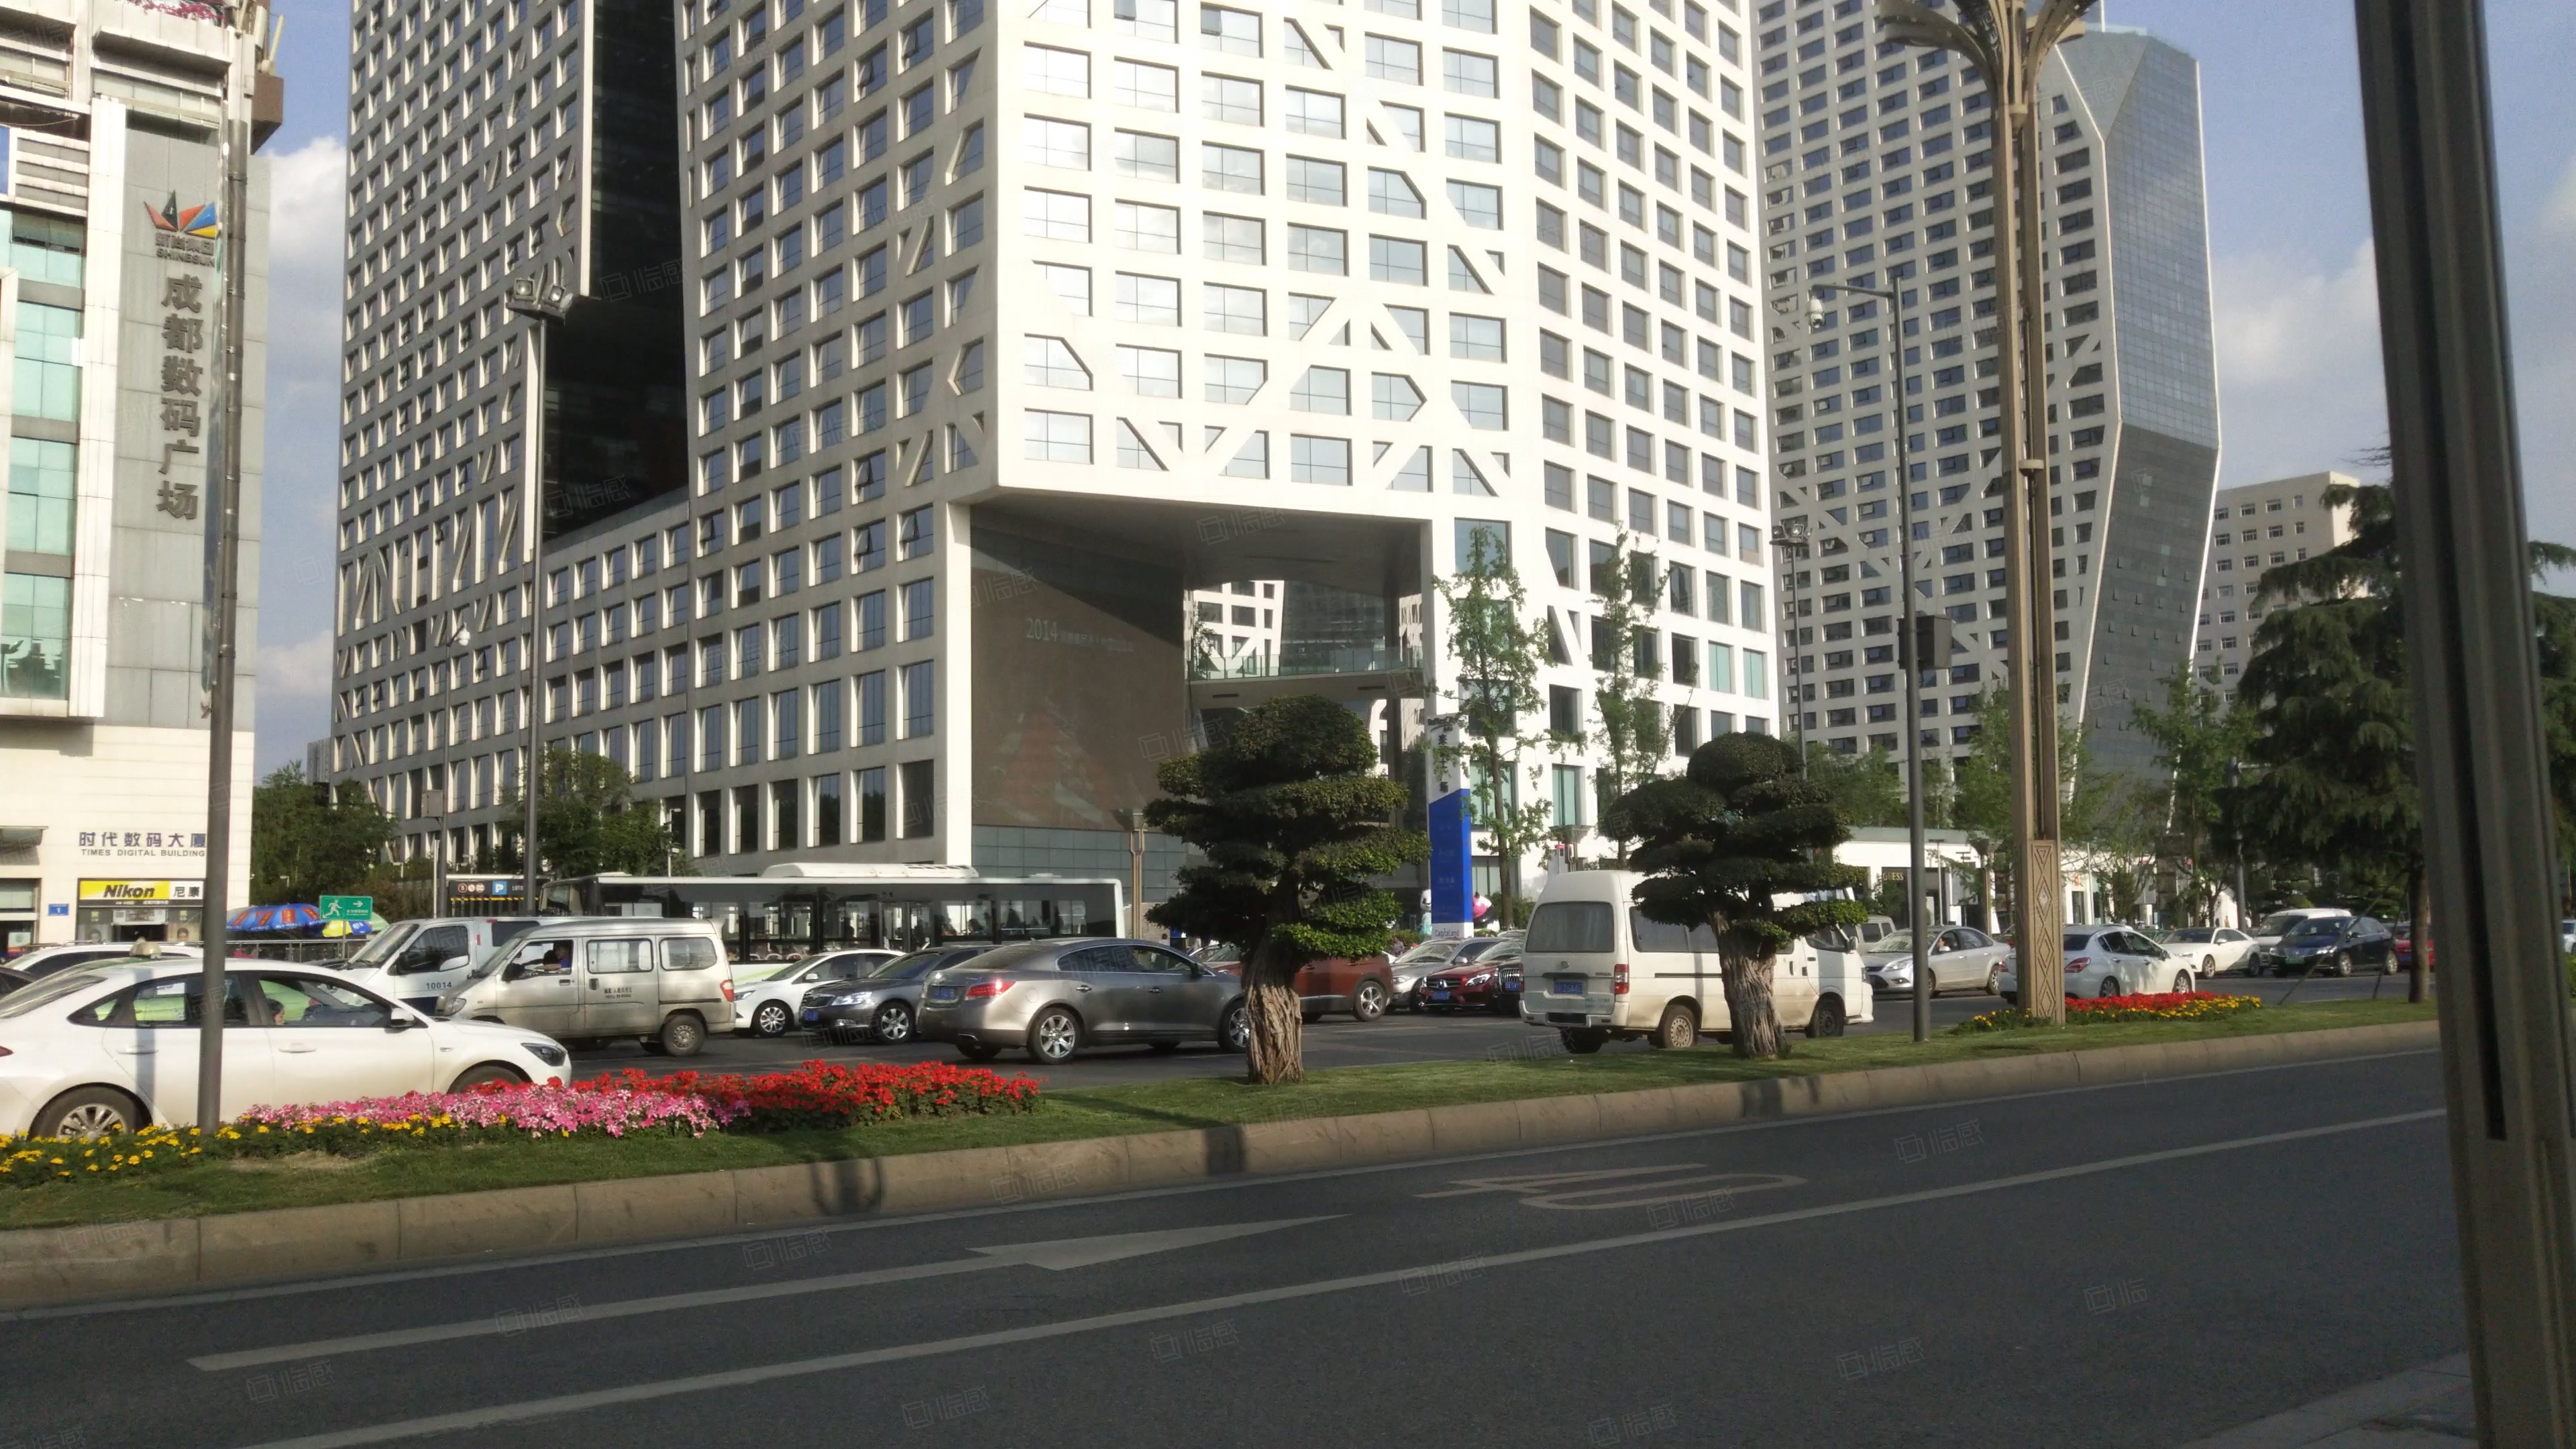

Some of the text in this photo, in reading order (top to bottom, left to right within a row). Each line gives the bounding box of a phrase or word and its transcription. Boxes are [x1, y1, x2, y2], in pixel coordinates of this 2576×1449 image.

[156, 273, 204, 520] 成都数码广场
[1025, 616, 1059, 642] 2014
[78, 831, 207, 848] 时代数码大厦
[81, 849, 205, 857] TIMES DIGITAL BUILDING
[103, 884, 156, 898] Nikon
[426, 981, 452, 989] 10014
